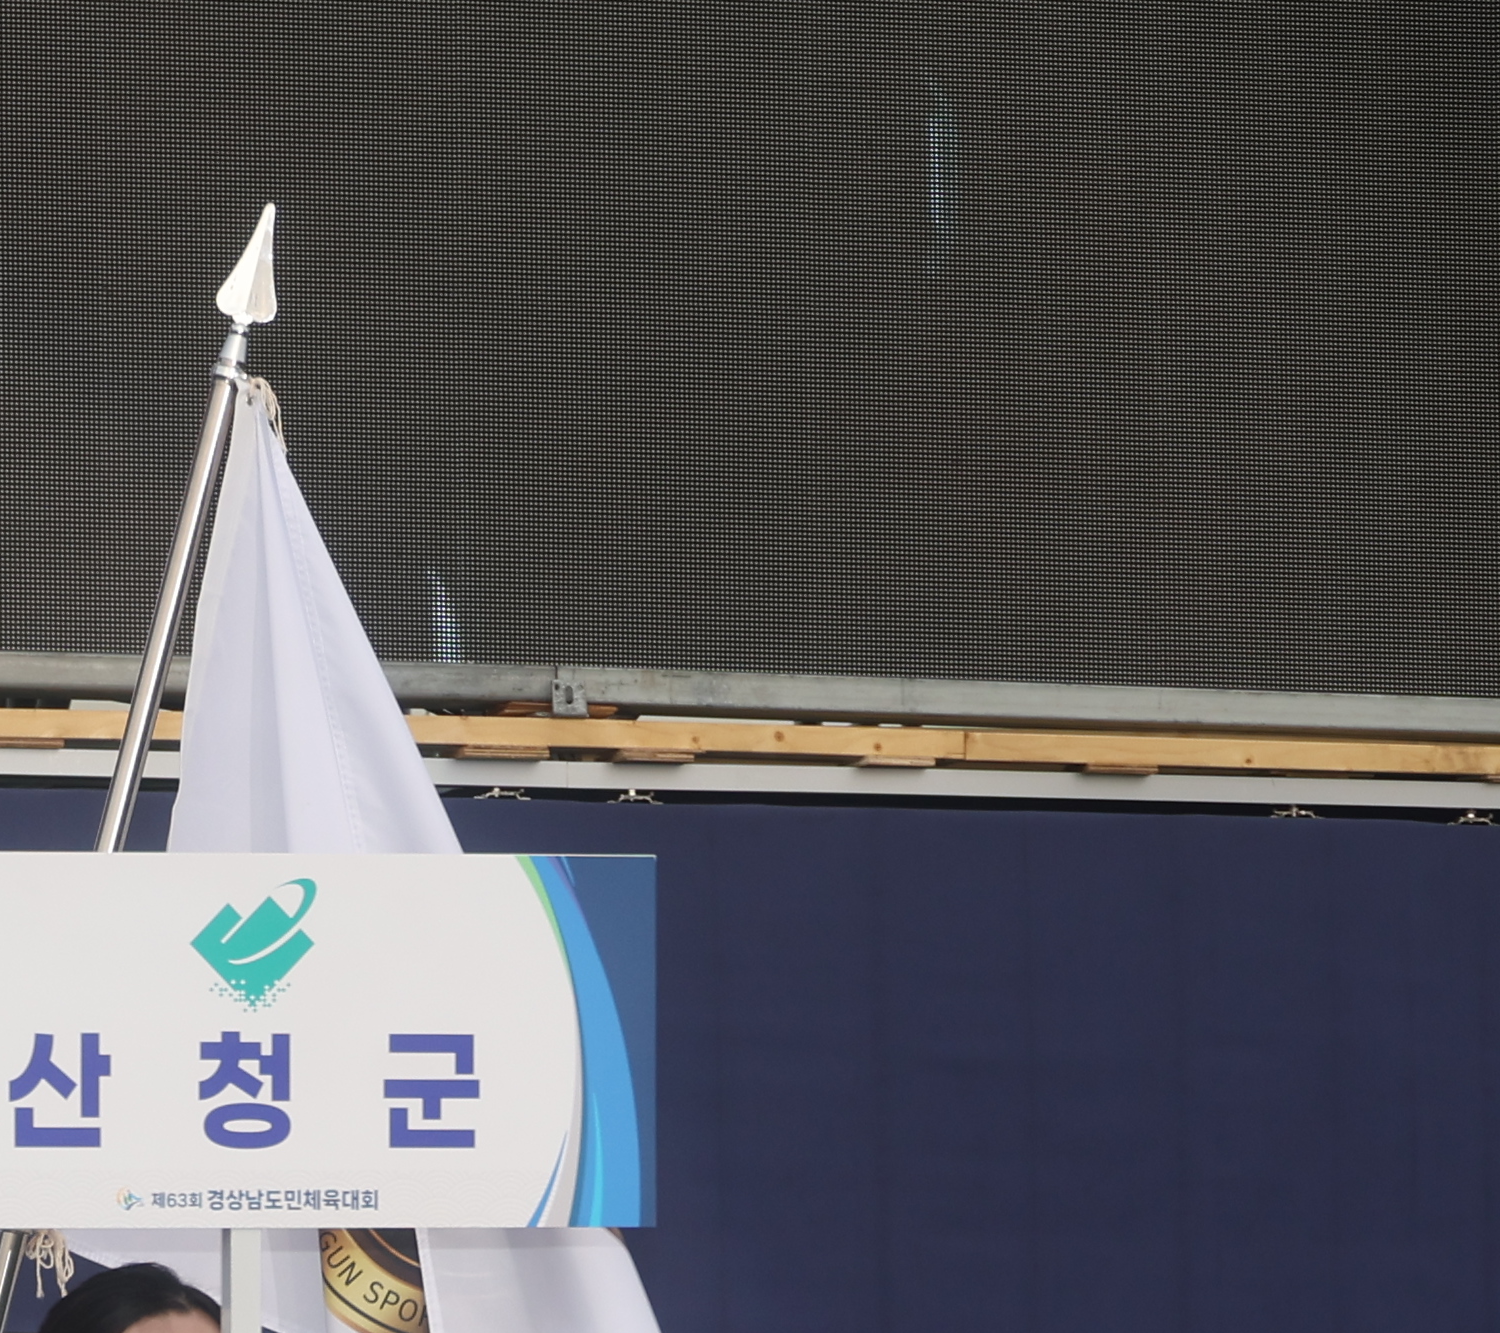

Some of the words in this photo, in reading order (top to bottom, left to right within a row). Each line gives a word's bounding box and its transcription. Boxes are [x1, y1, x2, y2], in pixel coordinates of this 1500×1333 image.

[8, 1031, 480, 1149] 산청군
[151, 1192, 202, 1208] 제63회
[207, 1189, 379, 1211] 경상남도민체육대회
